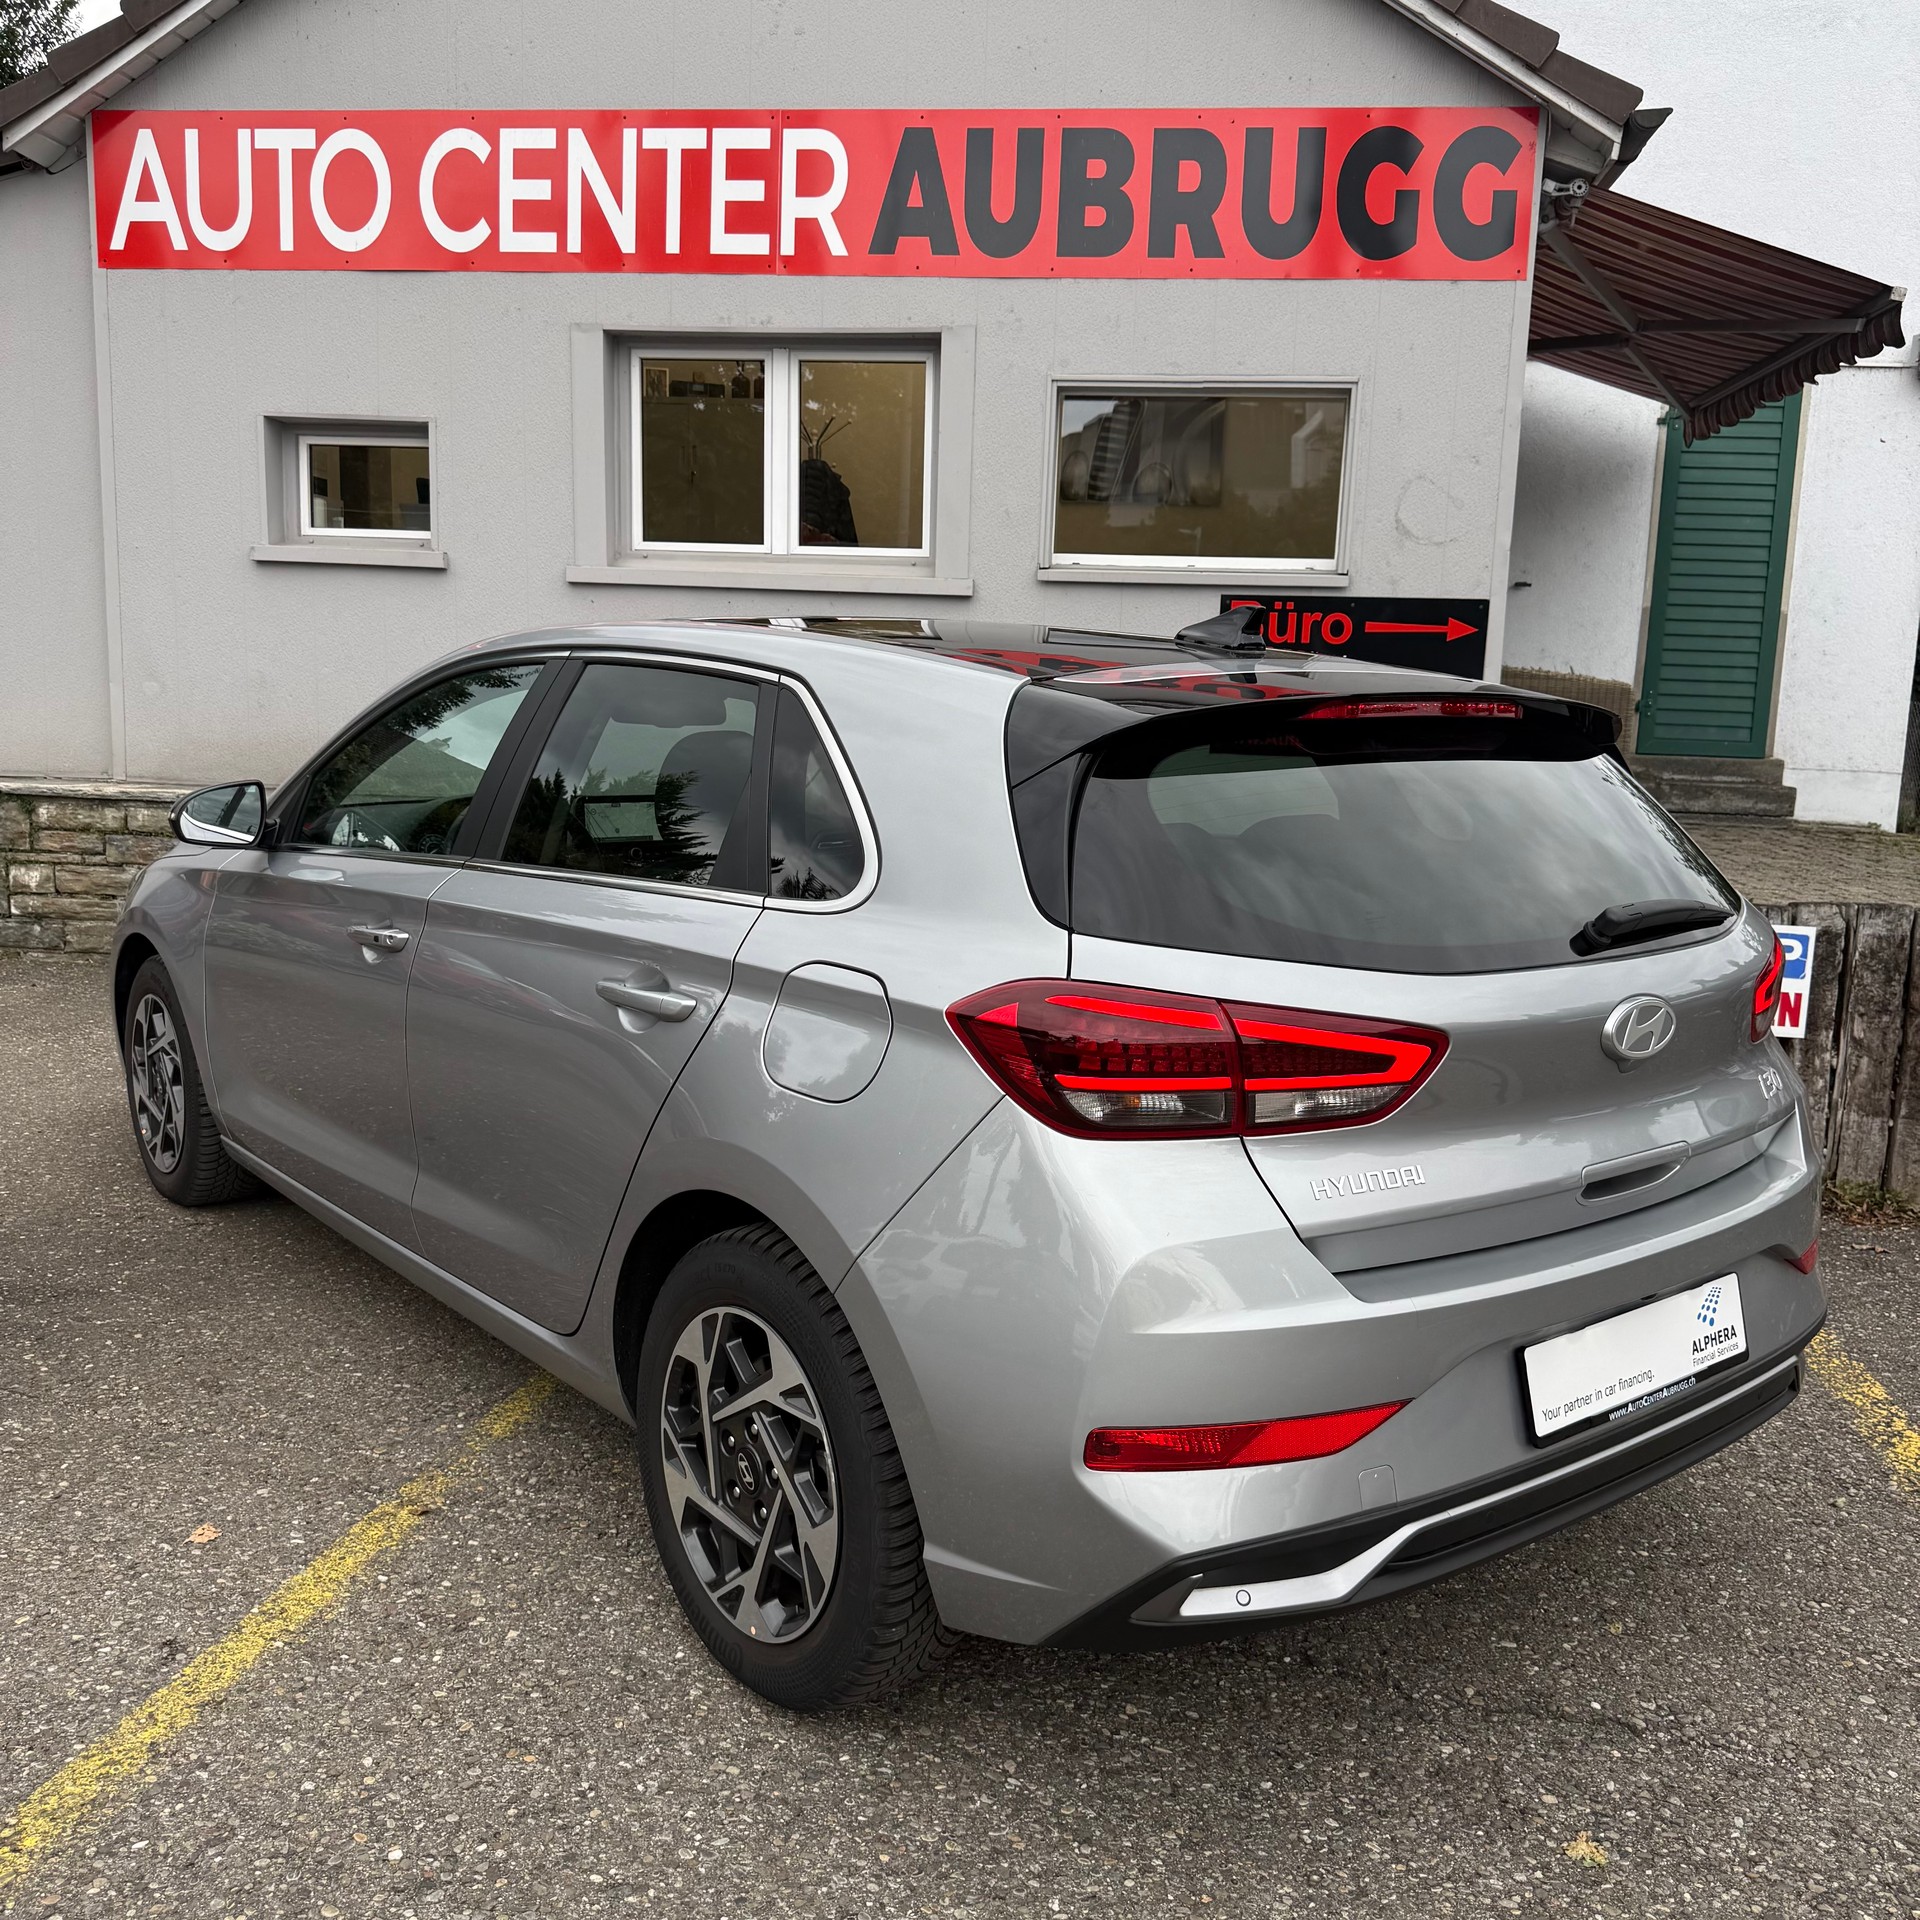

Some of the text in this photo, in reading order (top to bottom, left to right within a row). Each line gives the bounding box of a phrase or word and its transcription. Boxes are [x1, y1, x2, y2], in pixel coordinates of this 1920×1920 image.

[109, 125, 1523, 262] AUTO CENTER AUBRUGG
[1310, 1164, 1425, 1201] HYUNDAI
[1692, 1324, 1738, 1355] ALPHERA
[1693, 1342, 1739, 1368] Financial Services
[1542, 1368, 1655, 1422] Your partner in car financing.
